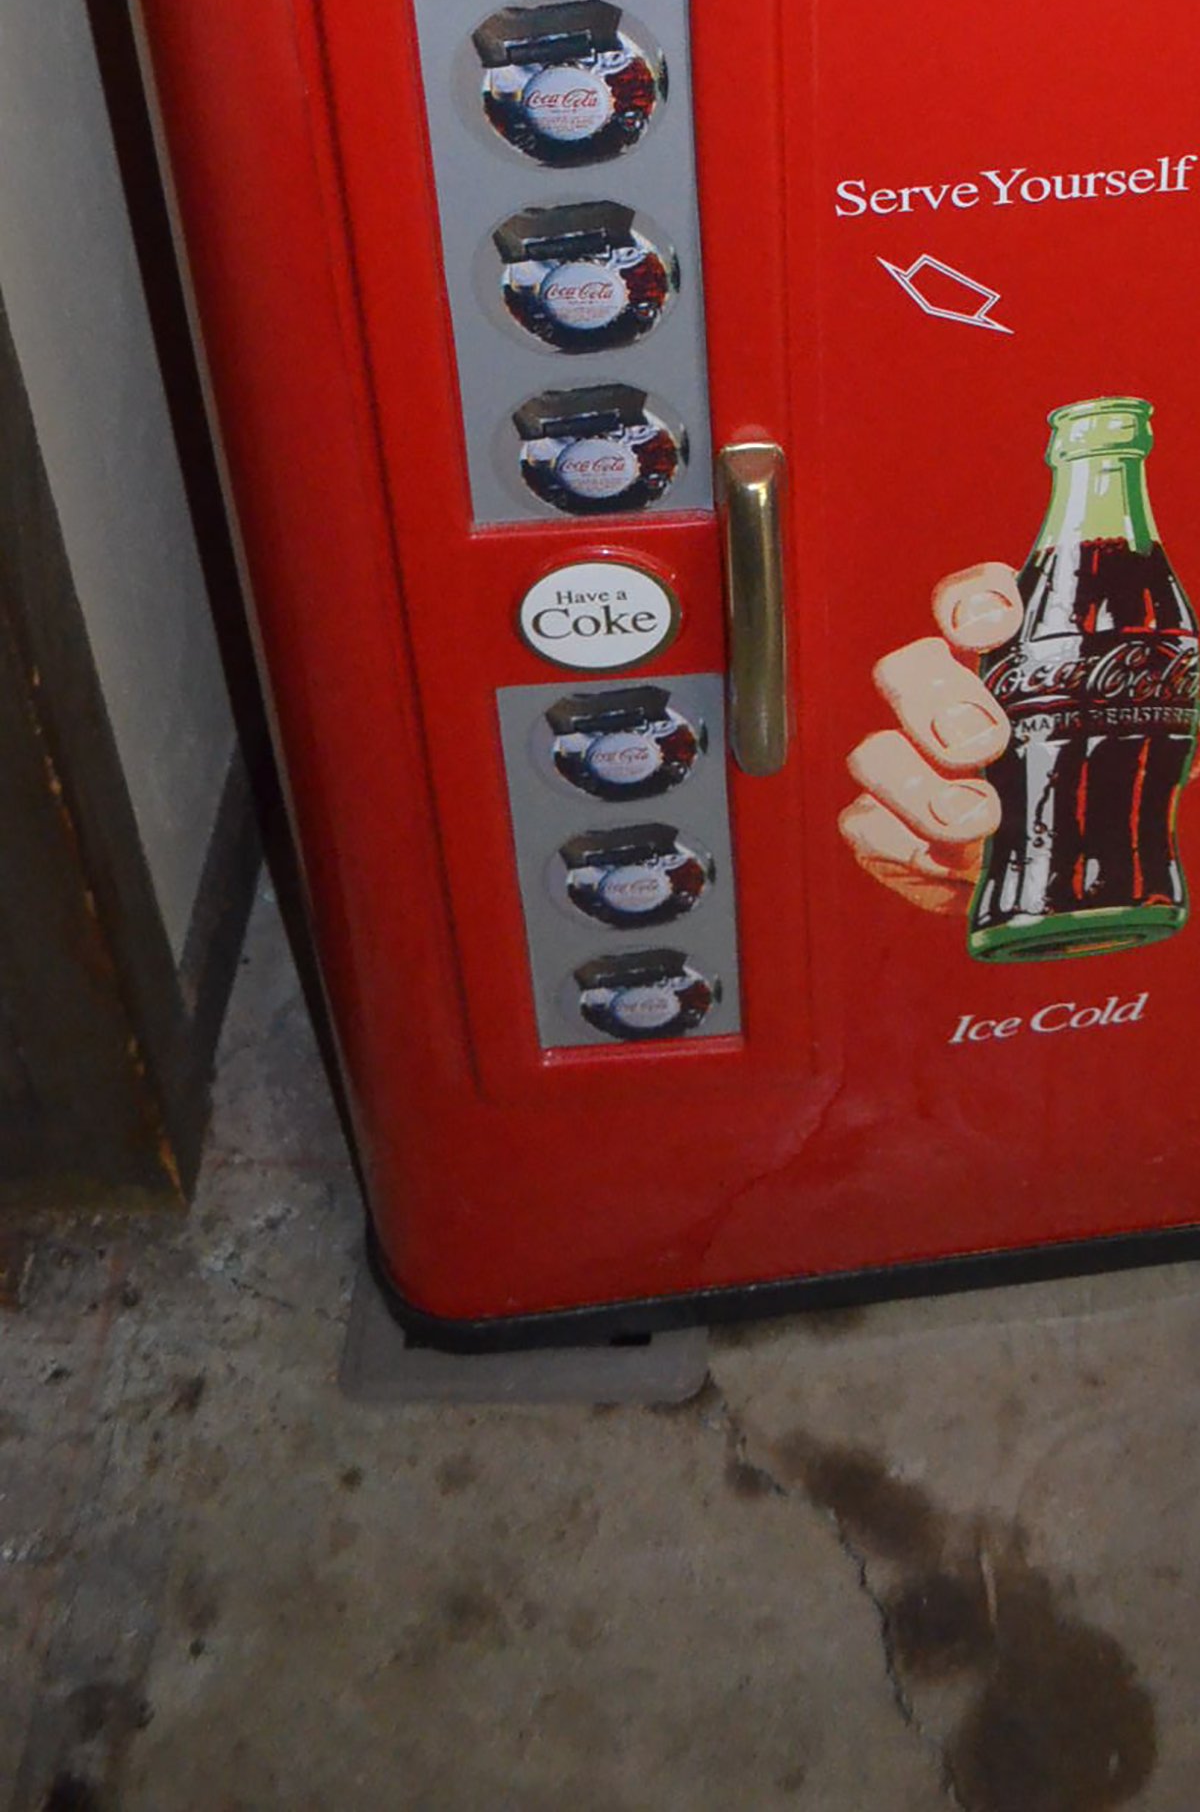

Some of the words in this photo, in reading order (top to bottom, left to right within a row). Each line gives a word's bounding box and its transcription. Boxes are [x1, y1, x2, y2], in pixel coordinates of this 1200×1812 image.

[834, 179, 980, 217] Serve
[980, 154, 1199, 206] Yourself
[556, 590, 610, 605] Have
[616, 590, 628, 601] a
[531, 604, 658, 640] Coke
[949, 1014, 1022, 1044] Ice
[1030, 992, 1149, 1033] Cold
